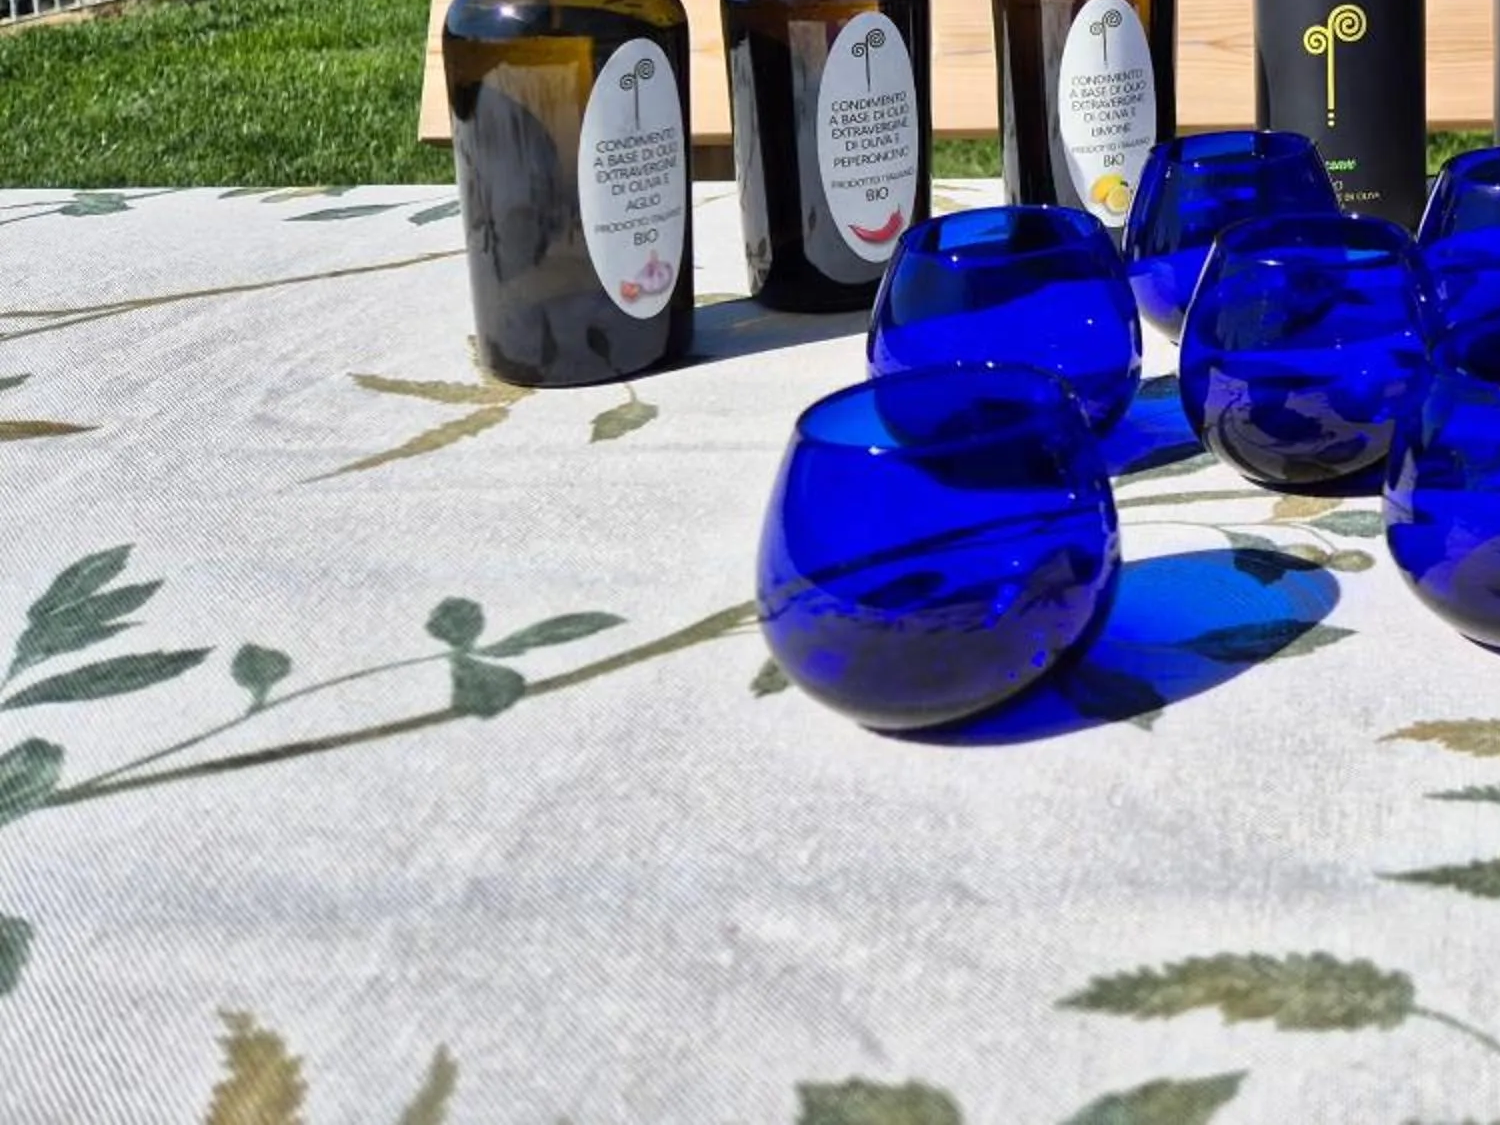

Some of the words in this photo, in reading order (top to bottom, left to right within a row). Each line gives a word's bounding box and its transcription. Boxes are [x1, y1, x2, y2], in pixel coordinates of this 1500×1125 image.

[1071, 69, 1143, 86] CONDIMENTO
[831, 91, 907, 112] CONDIMENTO
[841, 111, 869, 125] BASE
[1091, 122, 1131, 137] LIMONE
[861, 134, 893, 150] OLIVA
[833, 145, 909, 168] PEPERONCINO
[1103, 152, 1125, 168] BIO
[865, 186, 889, 202] BIO
[625, 193, 661, 213] AGLIO
[633, 227, 658, 246] BIO
